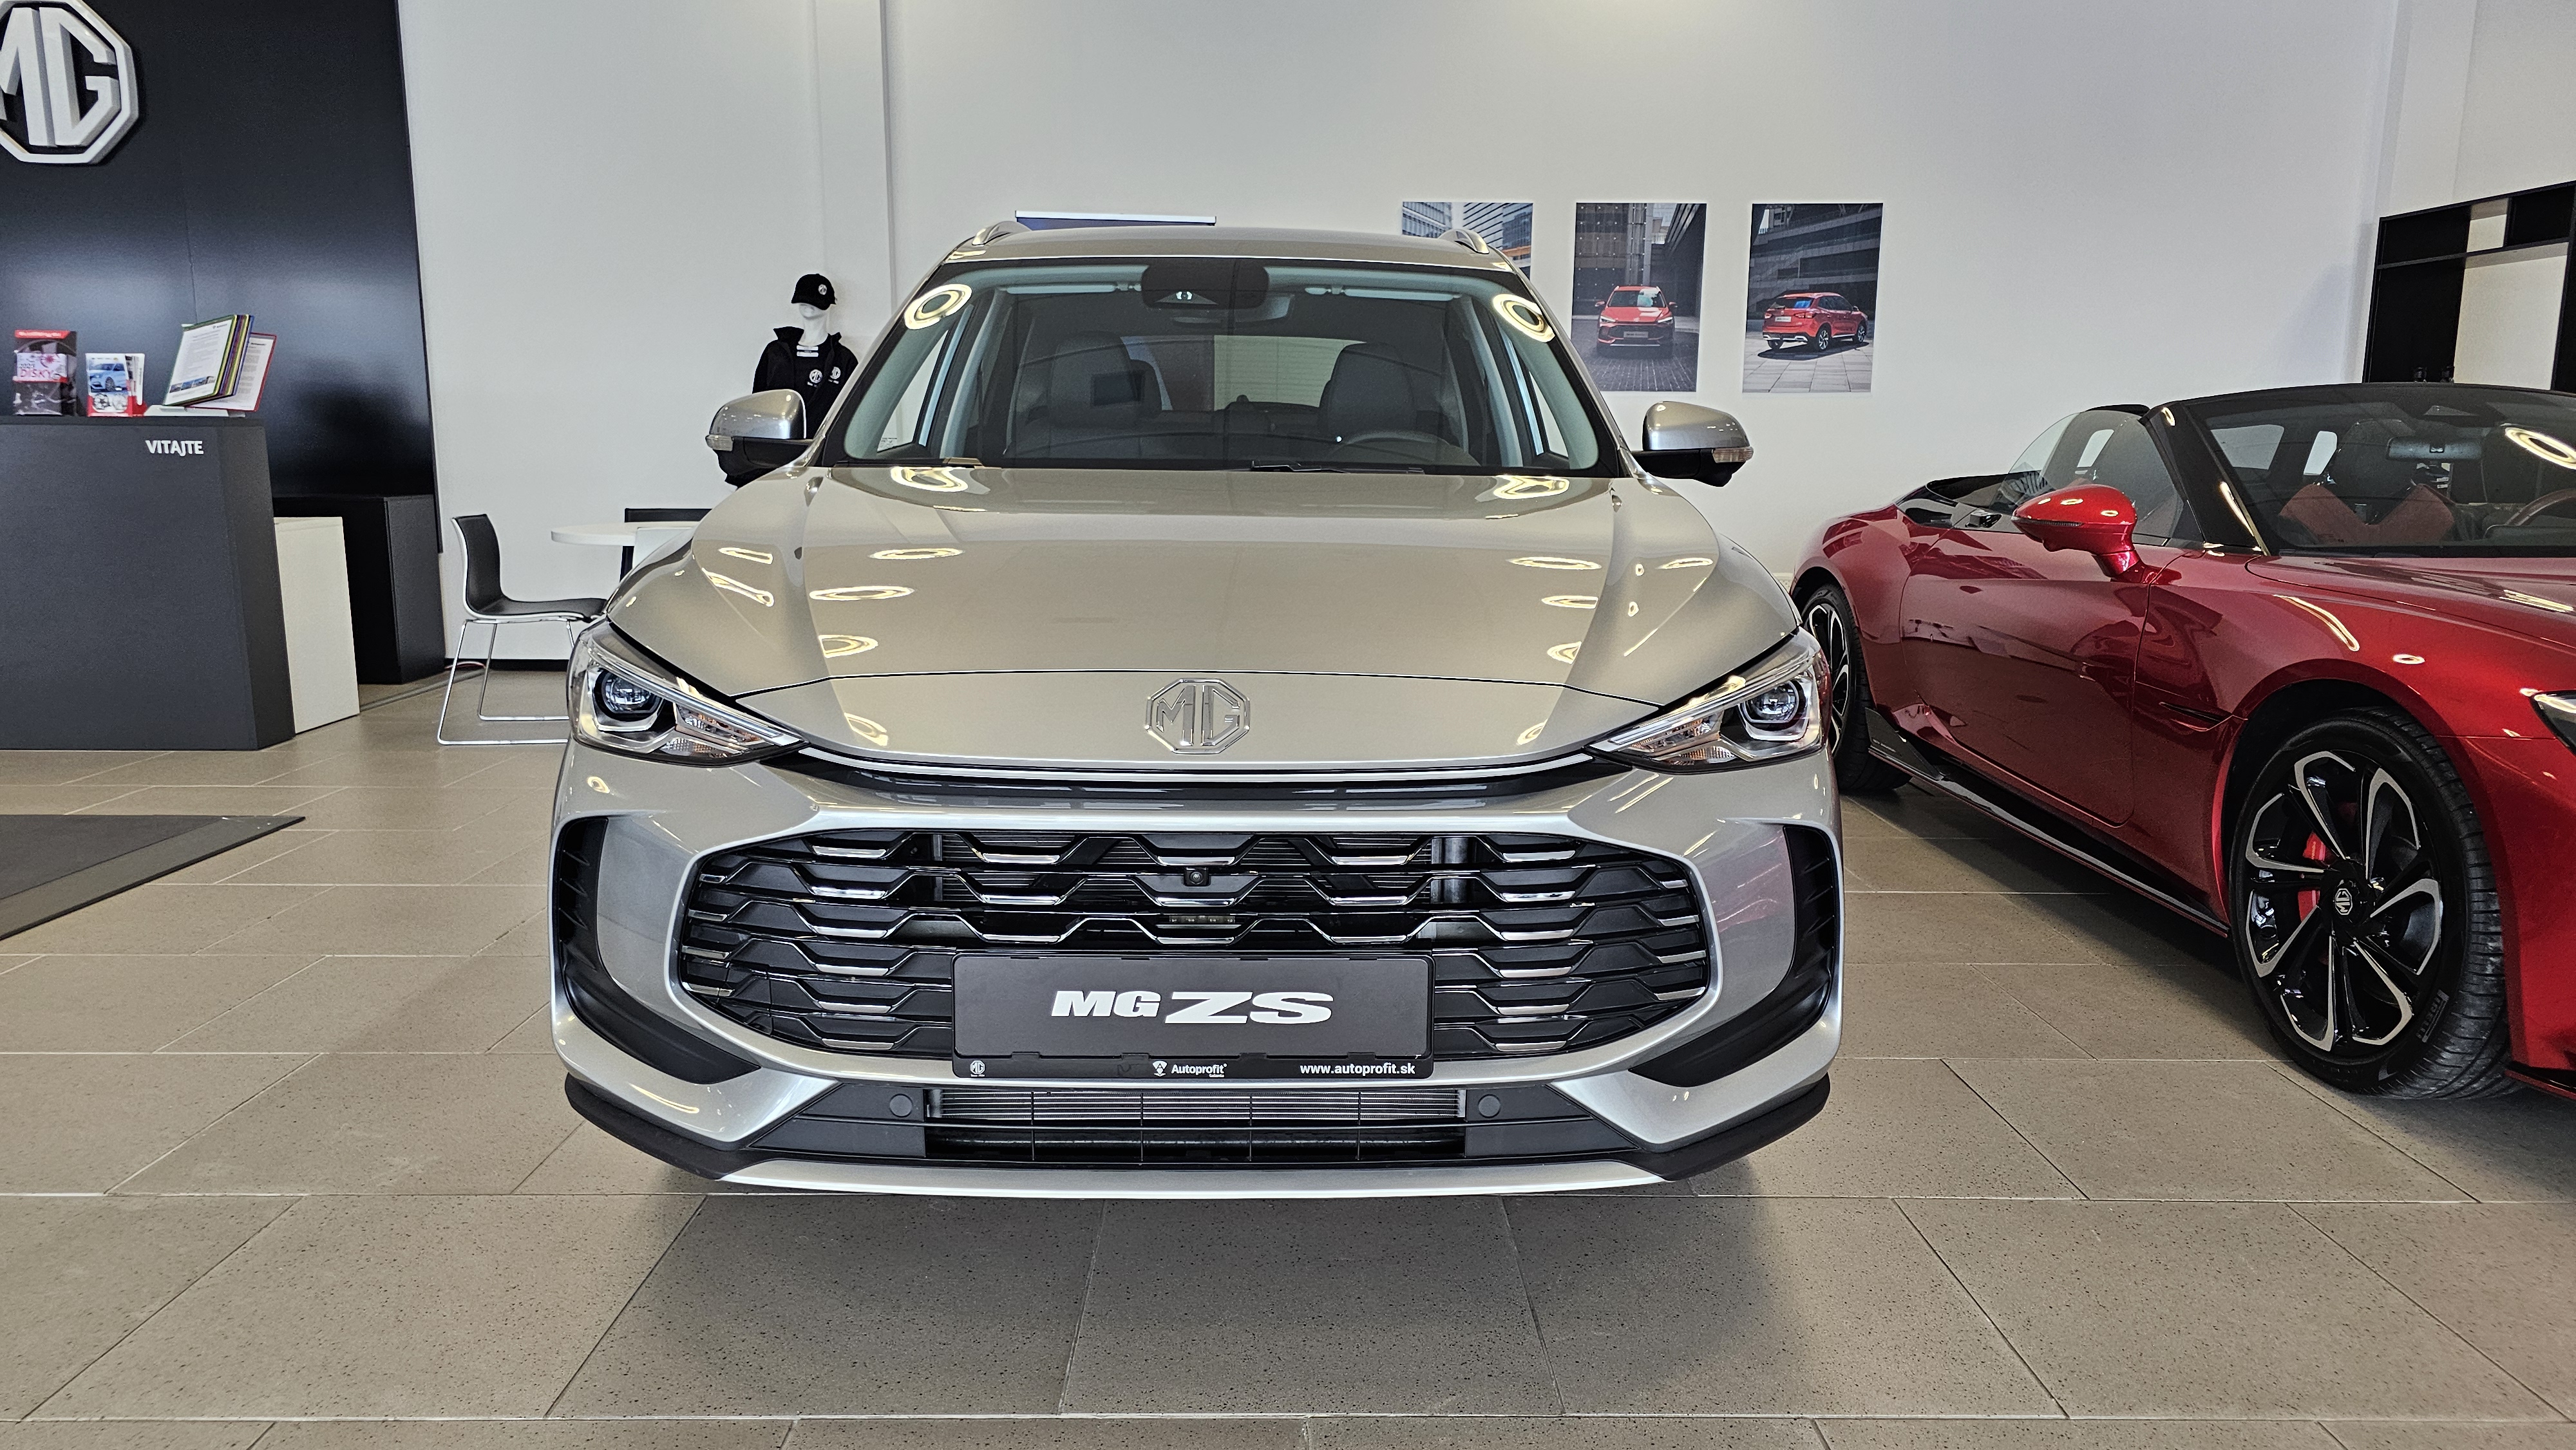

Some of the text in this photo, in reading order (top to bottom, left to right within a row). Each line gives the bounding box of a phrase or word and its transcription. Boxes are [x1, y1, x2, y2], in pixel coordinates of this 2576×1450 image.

[0, 6, 121, 147] MG
[145, 440, 204, 457] VITAJTE
[1153, 683, 1244, 748] MG
[2336, 890, 2351, 914] MG
[1051, 990, 1334, 1024] MG ZS
[972, 1062, 984, 1073] MG
[1300, 1062, 1416, 1076] www.autoprofit.sk
